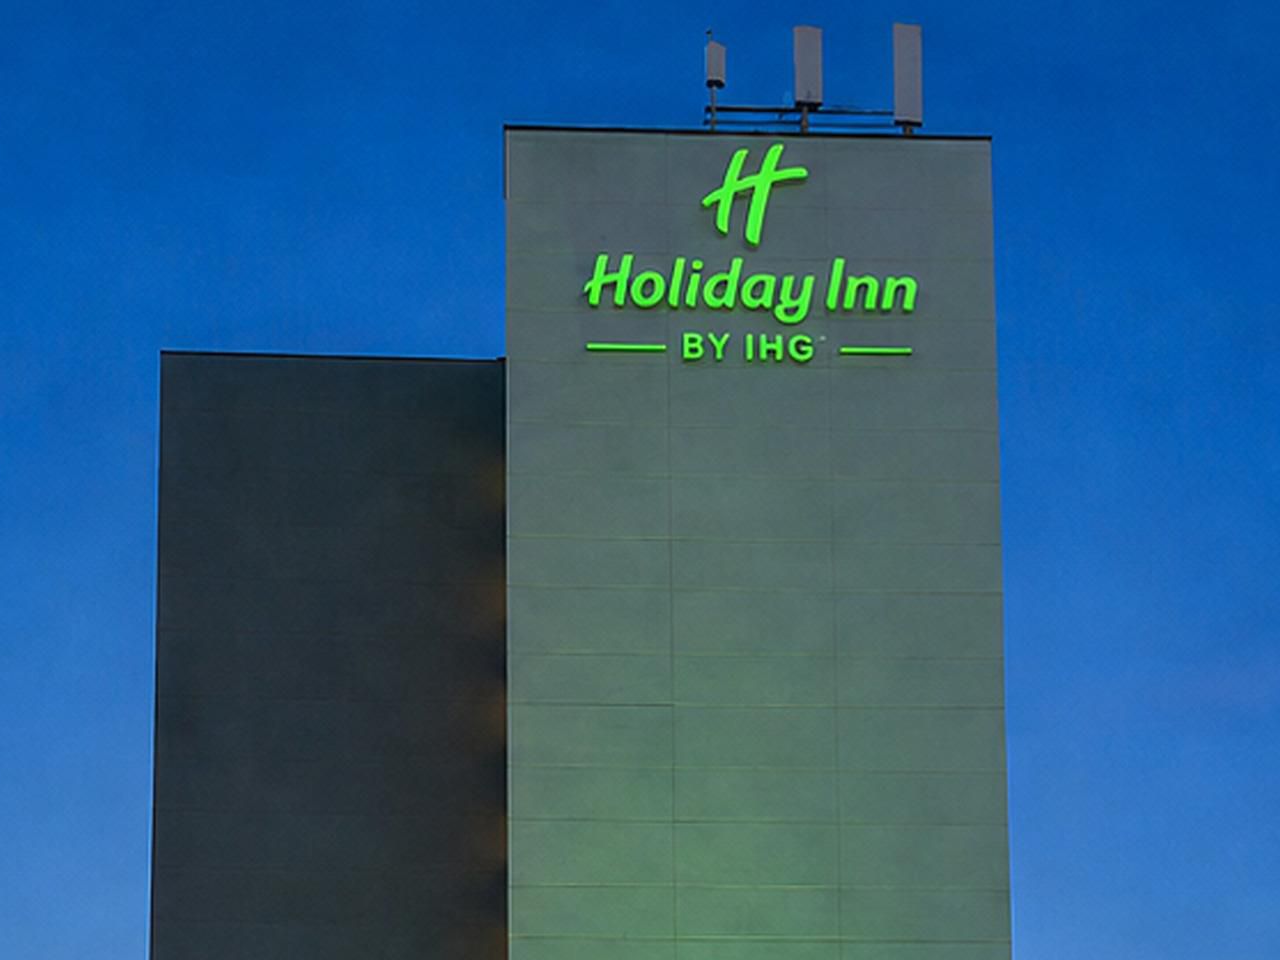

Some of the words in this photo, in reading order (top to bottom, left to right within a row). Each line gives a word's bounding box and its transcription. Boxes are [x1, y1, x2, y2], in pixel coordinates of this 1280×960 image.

[702, 143, 809, 247] H
[583, 253, 816, 325] Holiday
[825, 257, 918, 313] Inn
[681, 331, 730, 362] BY
[745, 333, 815, 363] IHG
